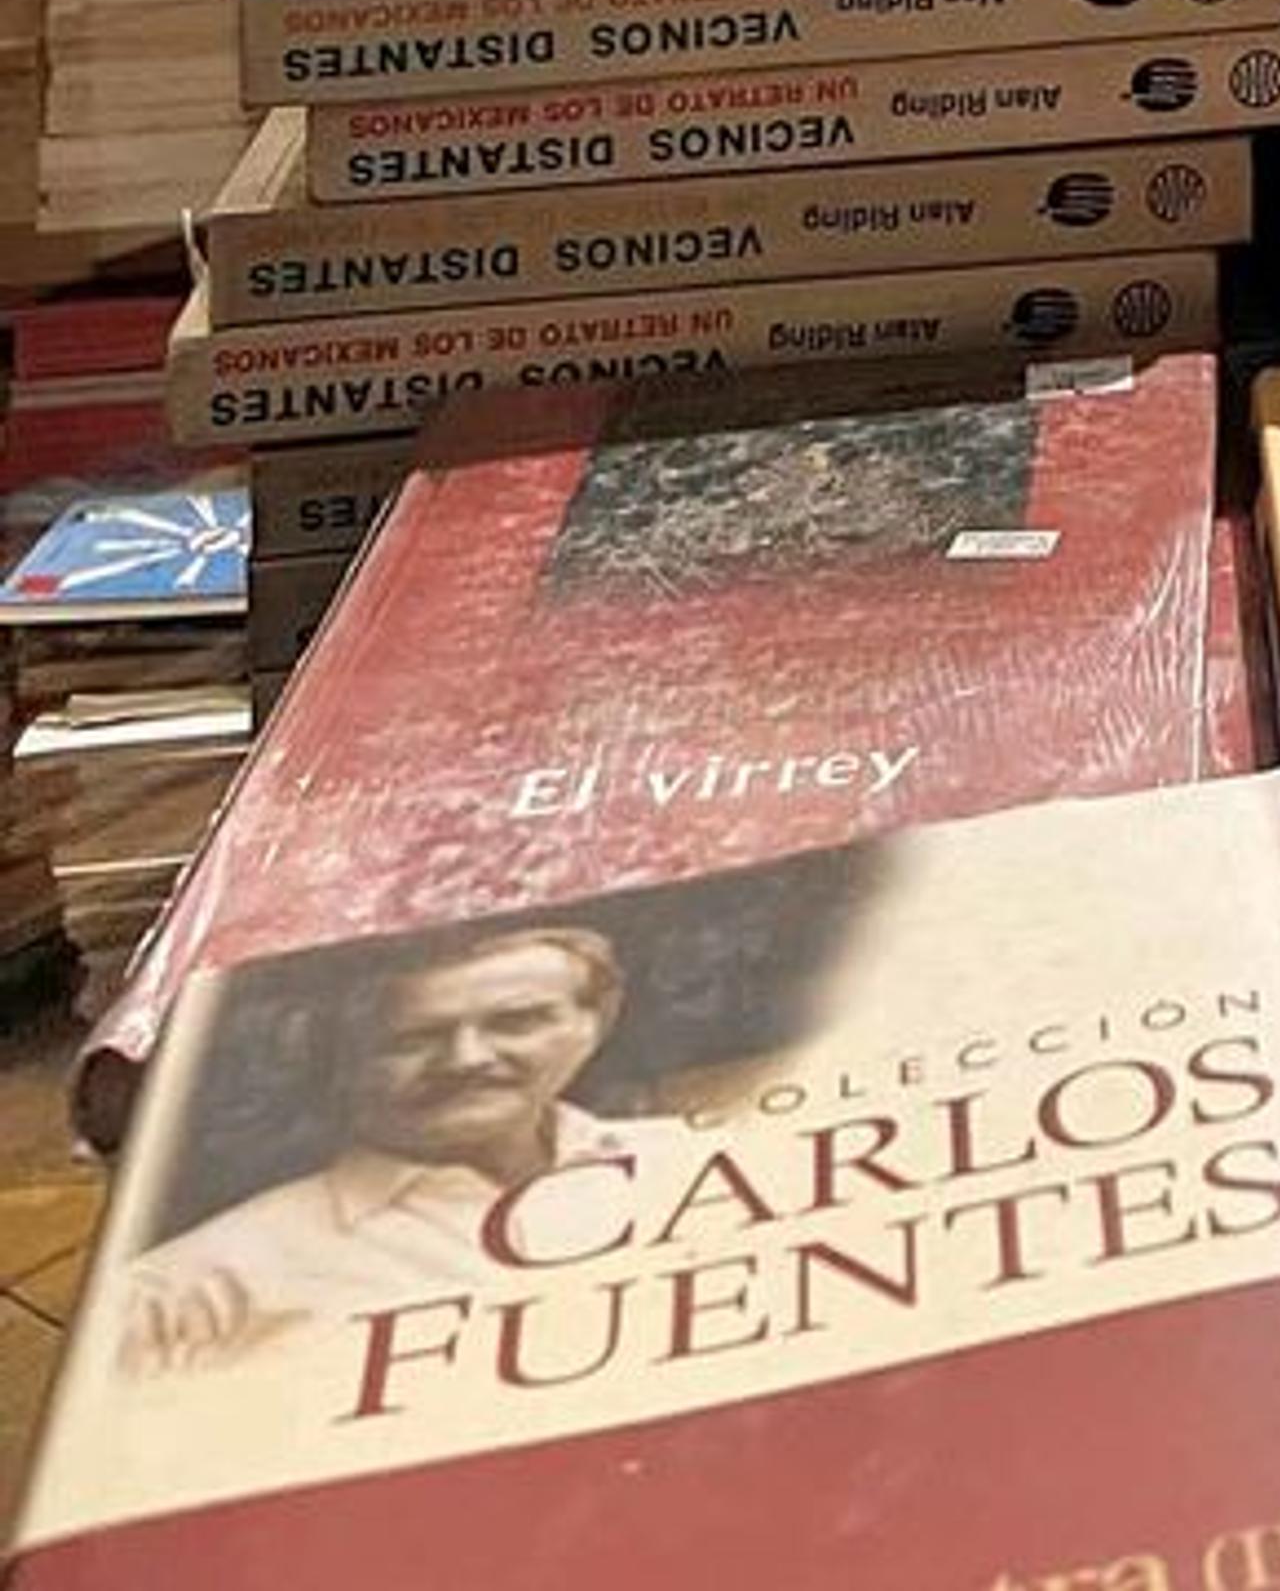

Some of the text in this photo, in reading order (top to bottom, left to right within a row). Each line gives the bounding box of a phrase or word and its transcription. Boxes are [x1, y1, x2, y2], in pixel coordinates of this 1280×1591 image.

[283, 9, 801, 83] VECINOS DISTANTES
[349, 76, 860, 140] UN RETRATO DE LOS MEXICANOS
[891, 83, 1062, 118] Alan Riding
[347, 113, 856, 188] VECINOS DISTANTES
[804, 198, 975, 234] Alan Riding
[246, 225, 763, 299] VECINOS DISTANTES
[212, 306, 735, 377] UN RETRATO DE LOS MEXICANOS
[768, 319, 868, 350] Riding
[507, 743, 922, 820] El virrey
[685, 987, 1266, 1131] COLECCIÓN
[478, 1033, 1280, 1273] CARLOS
